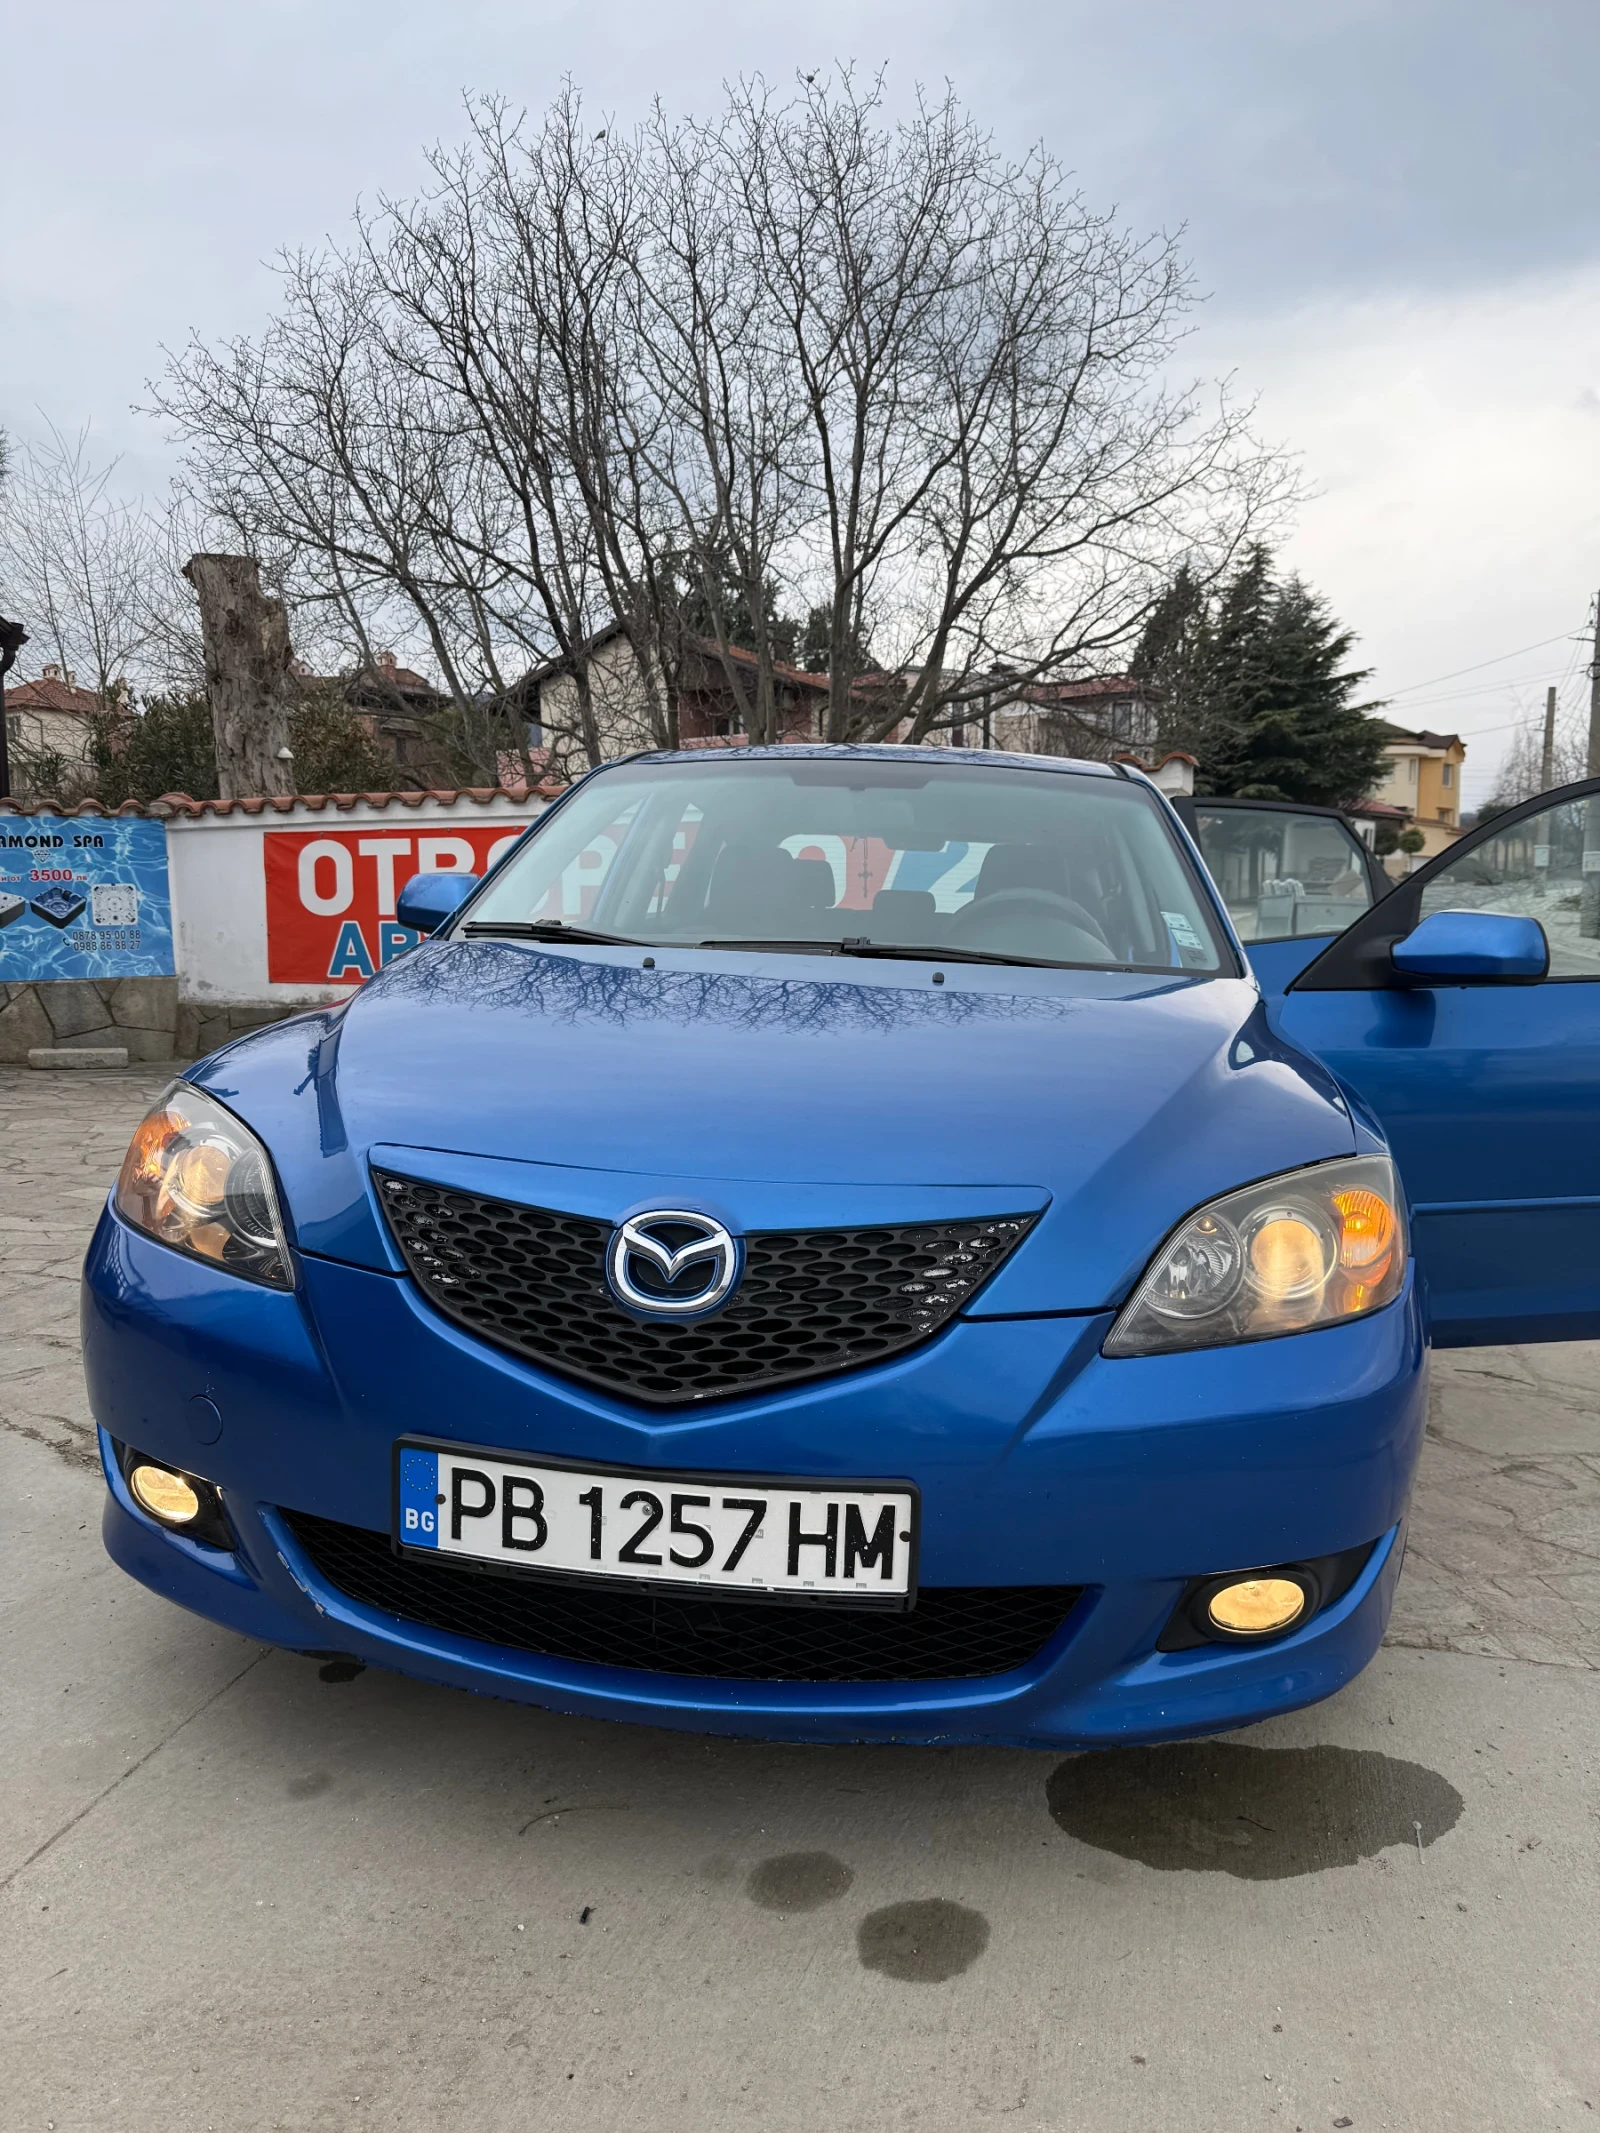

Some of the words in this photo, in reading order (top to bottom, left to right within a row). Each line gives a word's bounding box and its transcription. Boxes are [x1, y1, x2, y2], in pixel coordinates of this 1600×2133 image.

[73, 835, 104, 848] SPA
[30, 869, 73, 881] 3500
[72, 931, 97, 941] 0878
[100, 930, 112, 940] 95
[114, 930, 126, 940] 00
[129, 930, 141, 940] 88
[73, 941, 98, 951] 0988
[100, 941, 112, 951] 86
[115, 940, 127, 950] 88
[129, 940, 141, 950] 27
[405, 1507, 435, 1532] BG
[451, 1466, 548, 1551] PB
[578, 1485, 767, 1571] 1257
[786, 1501, 896, 1579] HM
